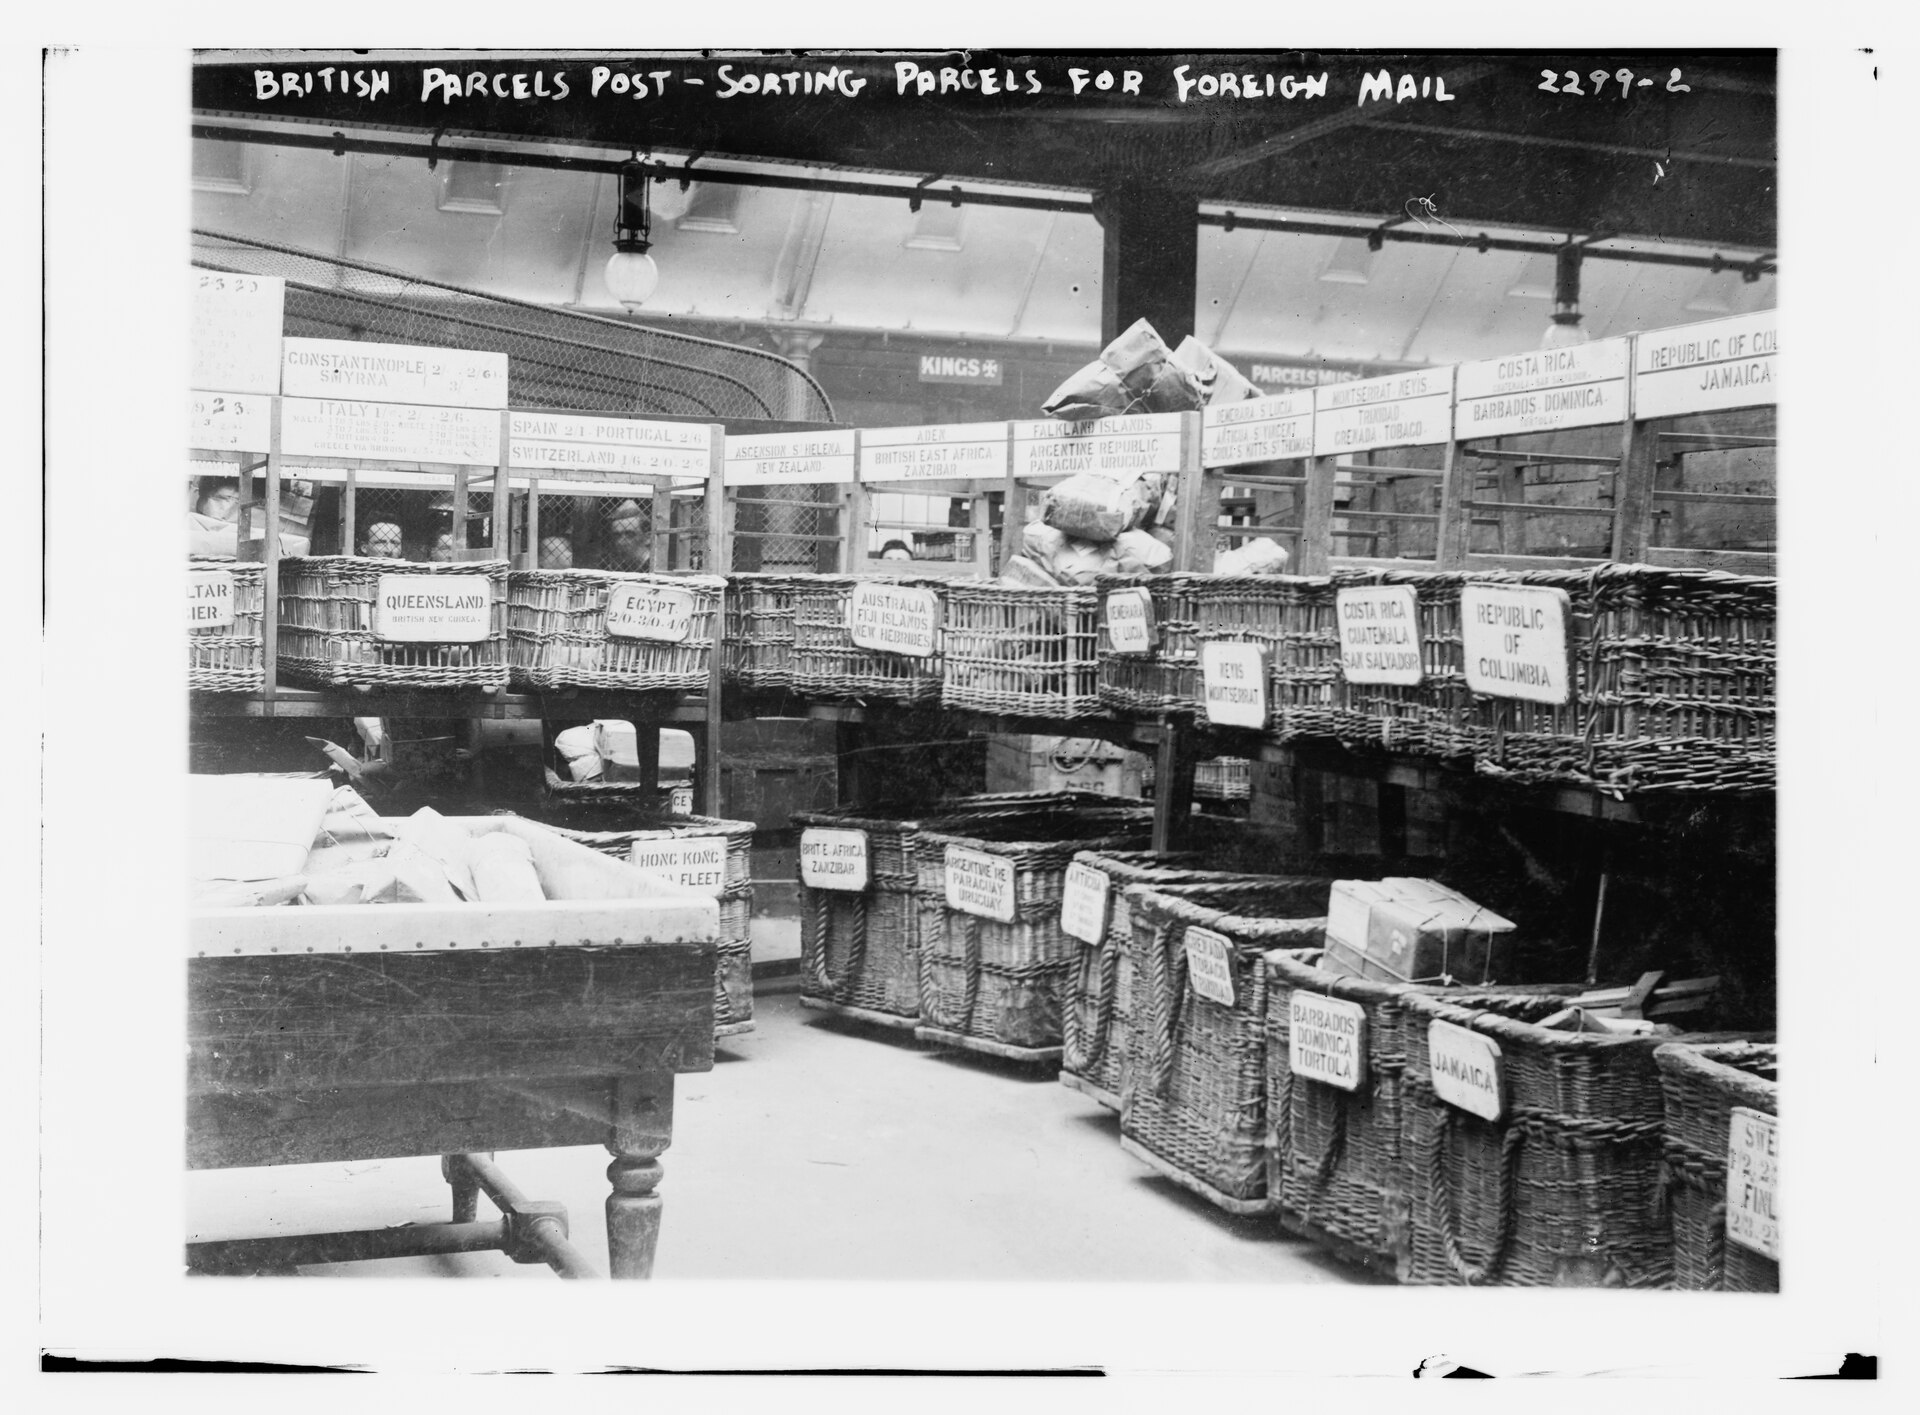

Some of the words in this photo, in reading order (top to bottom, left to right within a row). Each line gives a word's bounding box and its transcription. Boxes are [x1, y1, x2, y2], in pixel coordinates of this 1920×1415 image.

[1651, 338, 1721, 369] REPUBLIC
[1728, 334, 1745, 356] OF
[288, 351, 424, 375] CONSTANTINOPLE
[921, 355, 980, 376] KINGS
[1498, 357, 1539, 379] COSTA
[1544, 350, 1575, 372] RICA
[320, 369, 388, 387] SMYRNA
[1252, 365, 1317, 385] PARCELS
[1318, 368, 1362, 386] MUS
[1700, 362, 1772, 392] JAMAICA
[1332, 382, 1392, 406] MONTSERRAT
[1472, 397, 1537, 422] BARBADOS
[1544, 387, 1604, 413] DOMINICA
[320, 401, 369, 417] ITALY
[1358, 405, 1400, 427] TRINIDAD
[513, 420, 558, 435] SPAIN
[596, 425, 672, 443] PORTUGAL
[916, 428, 946, 442] ADEN
[1033, 420, 1095, 438] FALKLAND
[1099, 418, 1153, 433] ISLANDS
[1334, 423, 1377, 447] GRENADA
[512, 446, 616, 465] SWITZERLAND
[735, 444, 786, 459] ASCENSION
[805, 442, 842, 456] HELENA
[875, 450, 916, 465] BRITISH
[920, 448, 948, 463] EAST
[953, 447, 993, 461] AFRICA
[1030, 441, 1094, 458] ARGENTINE
[1100, 439, 1159, 455] REPUBLIC
[756, 461, 775, 474] NEW
[779, 460, 822, 473] ZEALAND
[904, 463, 957, 478] ZANZIBAR
[1030, 457, 1093, 473] PARAGUAY
[1101, 455, 1157, 470] URUGUAY
[861, 592, 927, 615] AUSTRALIA
[1343, 601, 1378, 619] COSTA
[1381, 600, 1407, 619] RICA
[857, 607, 879, 624] FIJI
[881, 610, 929, 631] ISLANDS
[1477, 602, 1545, 630] REPUBLIC
[853, 623, 876, 641] NEW
[880, 626, 931, 649] HEBRIDES
[1348, 626, 1411, 645] GUATEMALA
[1504, 634, 1521, 655] OF
[1343, 652, 1365, 670] SAN
[1366, 652, 1419, 671] SALVADOR
[1479, 657, 1552, 688] COLUMBIA
[640, 852, 678, 867] HONG
[812, 860, 855, 875] ZANZIBAR
[680, 872, 721, 886] FLEET
[952, 872, 1004, 895] PARAGUAY
[958, 887, 1002, 911] URUGUAY
[1293, 1004, 1355, 1036] BARBADOS
[1297, 1026, 1352, 1058] DOMINICA
[1298, 1047, 1352, 1080] TORTOLA
[1434, 1052, 1494, 1094] JAMAICA
